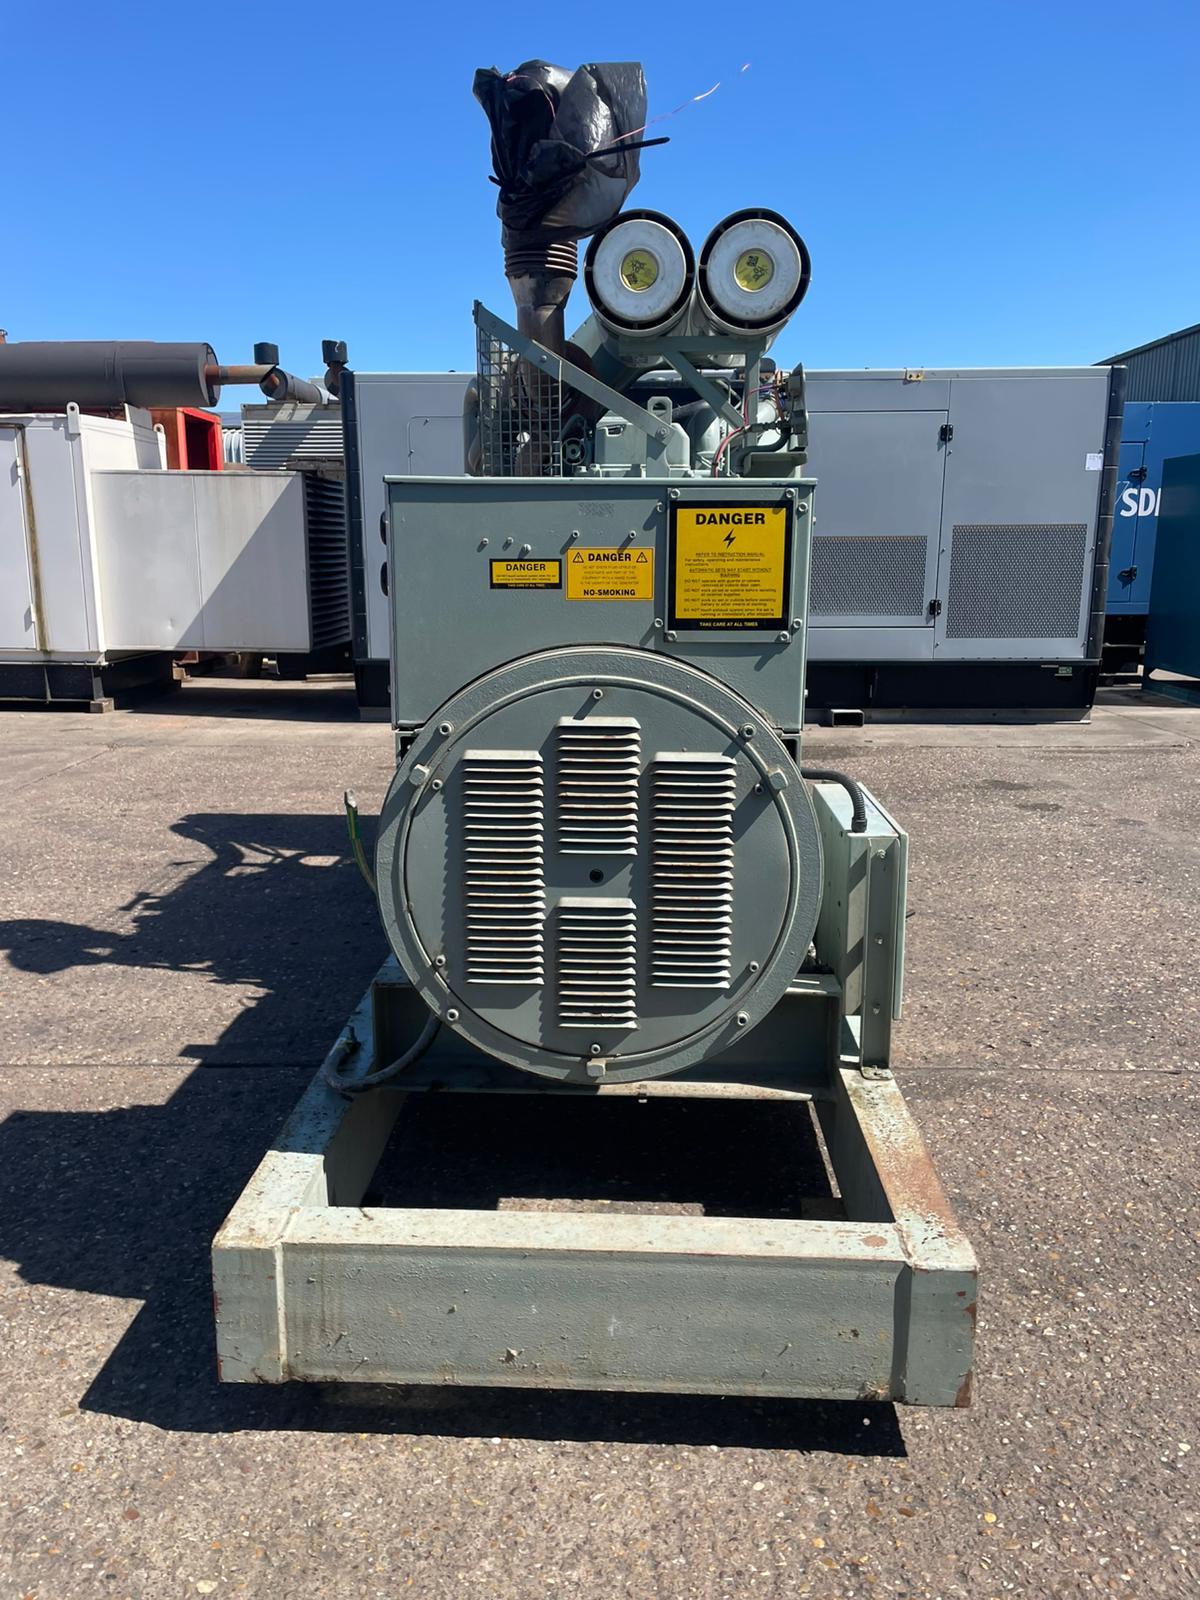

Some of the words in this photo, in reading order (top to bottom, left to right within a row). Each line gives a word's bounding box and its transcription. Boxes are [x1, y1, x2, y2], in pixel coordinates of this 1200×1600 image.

[1120, 488, 1161, 517] SD
[695, 512, 766, 525] DANGER
[588, 553, 632, 562] DANGER
